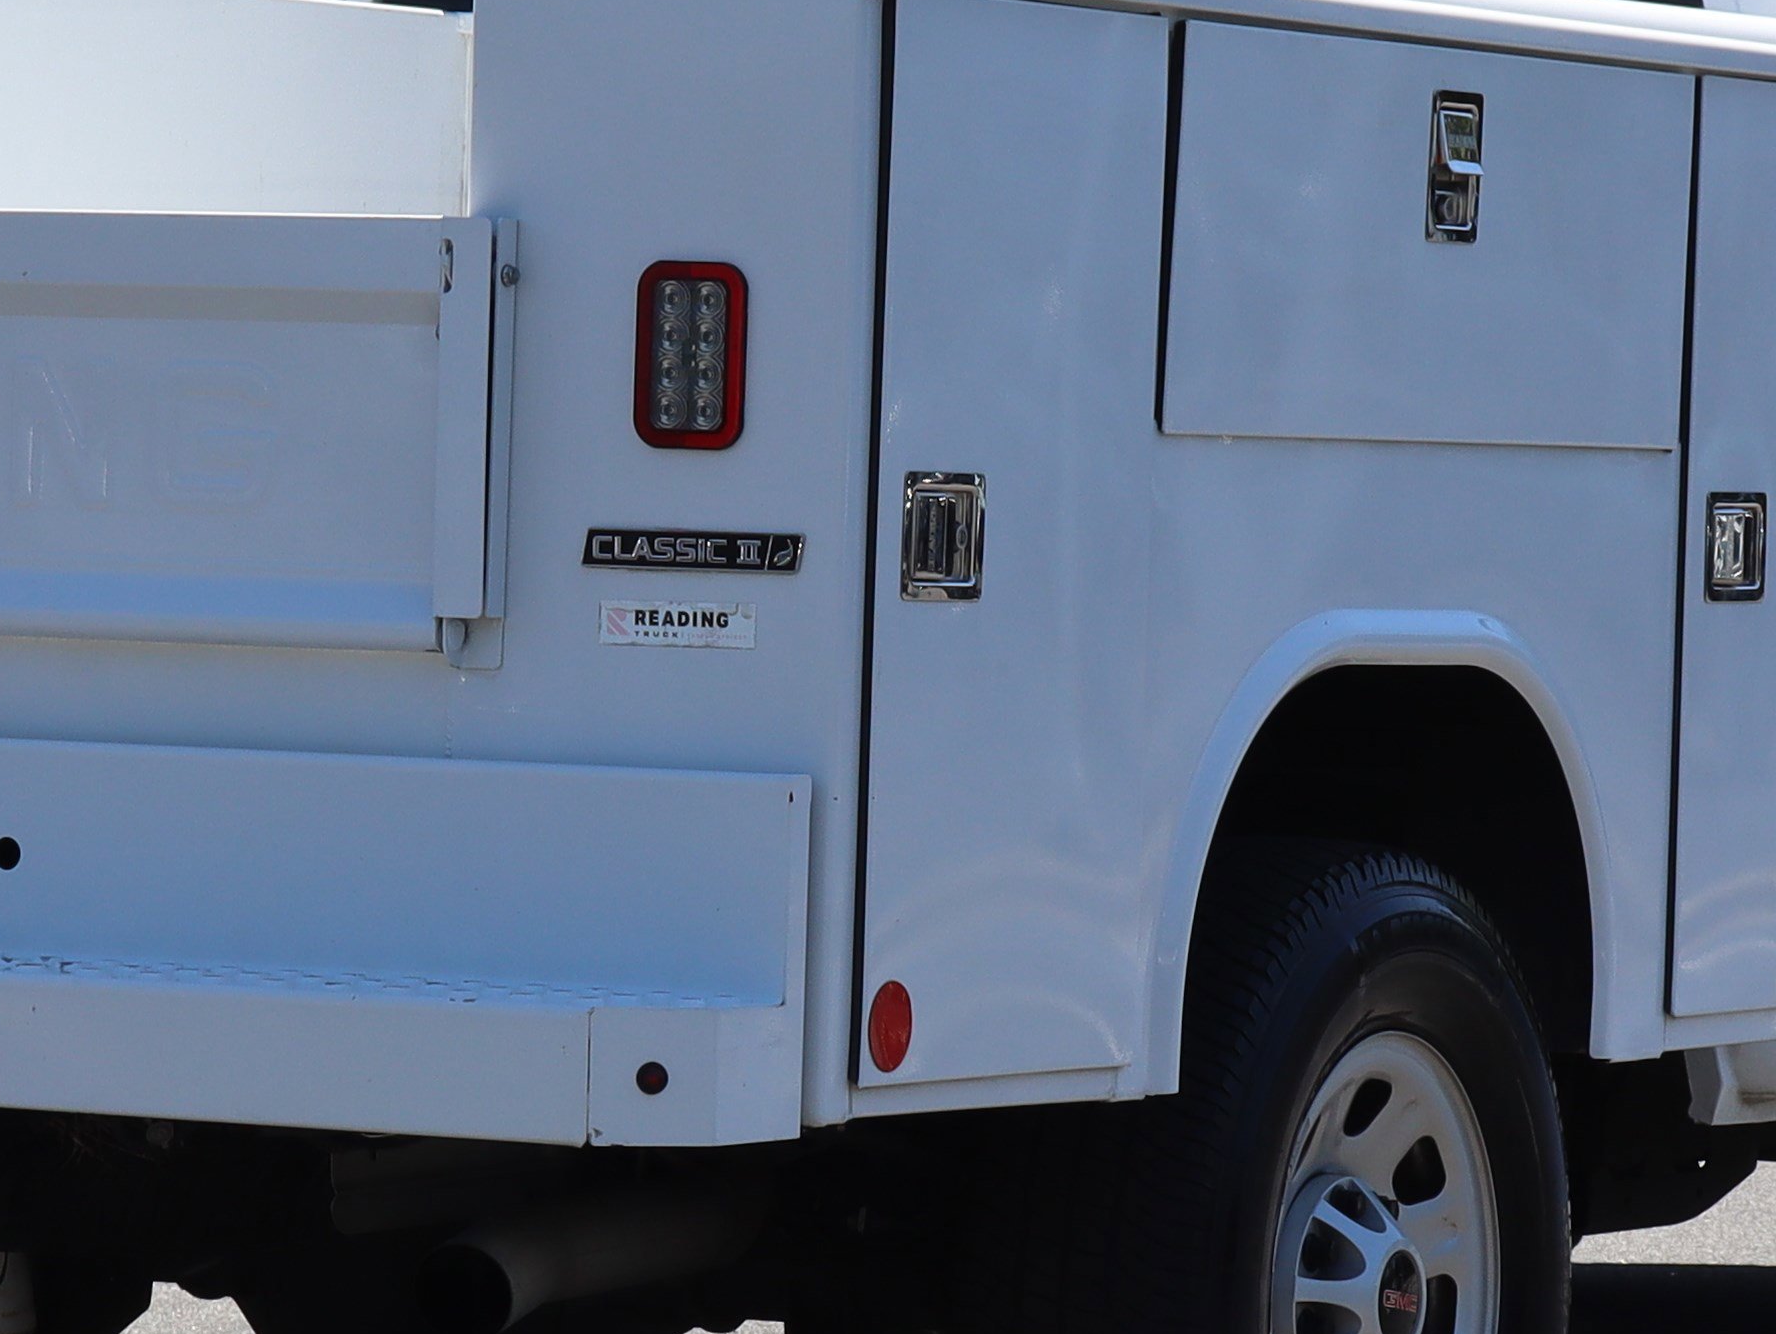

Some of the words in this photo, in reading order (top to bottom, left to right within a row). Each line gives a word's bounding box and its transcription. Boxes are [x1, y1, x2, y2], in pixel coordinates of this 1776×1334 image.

[592, 535, 728, 564] CLASSIC
[736, 539, 762, 565] II
[634, 609, 730, 629] READING
[634, 630, 679, 639] TRUCK
[1383, 1289, 1418, 1313] GMC
